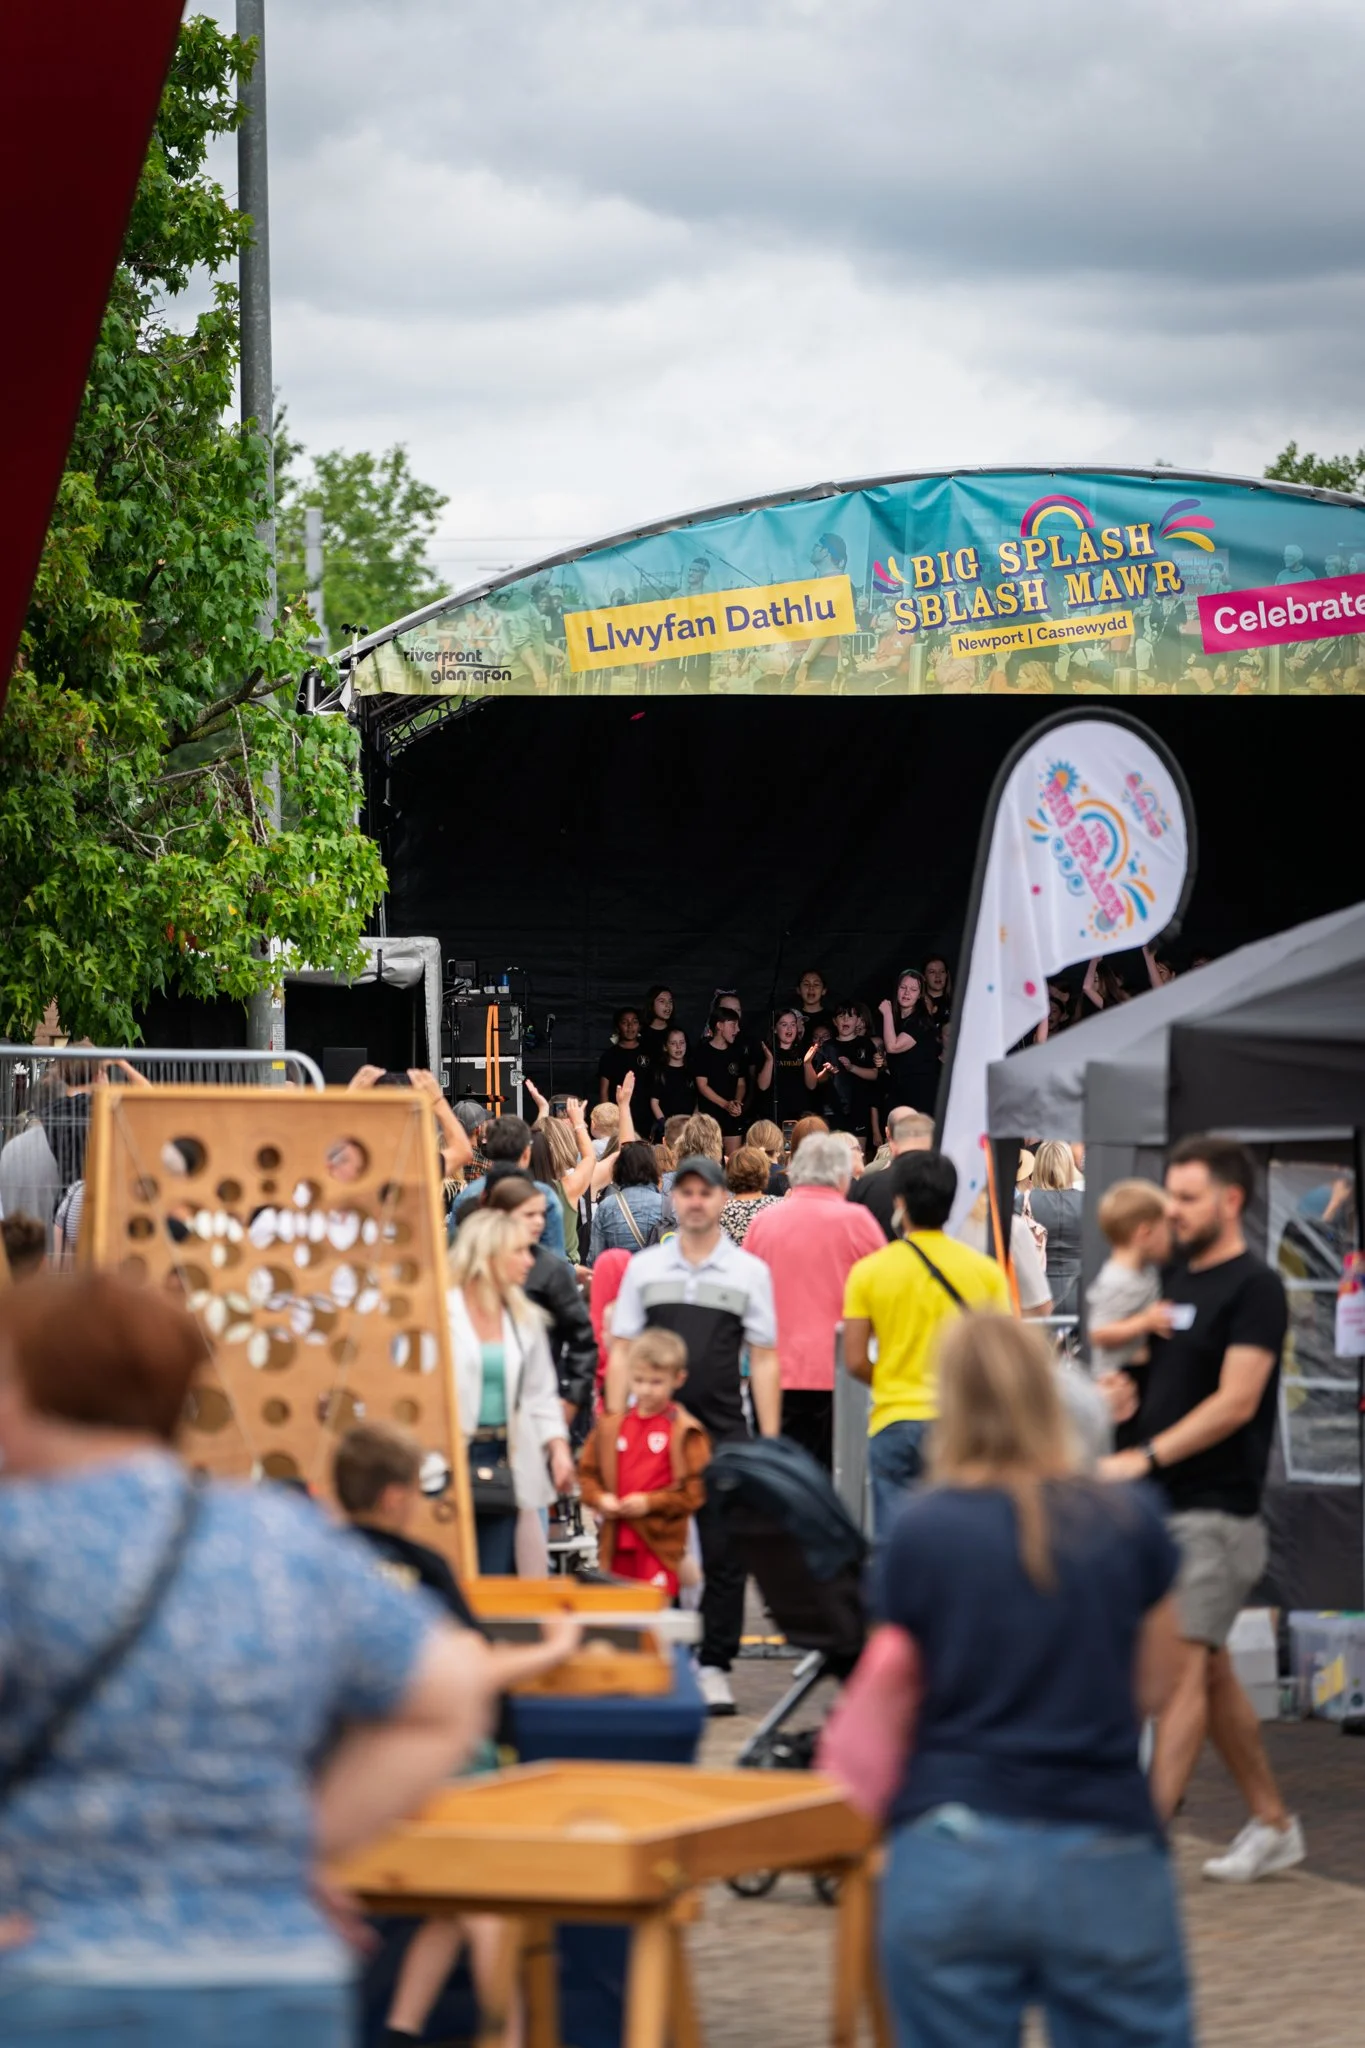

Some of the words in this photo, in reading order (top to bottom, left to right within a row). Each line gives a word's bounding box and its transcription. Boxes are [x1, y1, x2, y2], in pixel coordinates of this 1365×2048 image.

[910, 547, 980, 592] BIG
[998, 522, 1156, 576] SPLASH
[894, 573, 1051, 634] SBLASH
[1064, 560, 1184, 608] MAWR
[1213, 591, 1365, 635] Celebrate
[585, 611, 717, 653] Llwyfan
[725, 593, 836, 633] Dathlu
[958, 629, 1025, 652] Newport
[1037, 614, 1128, 641] Casnewydd
[403, 647, 482, 666] riverfront
[430, 667, 467, 685] glan
[473, 669, 512, 684] afon
